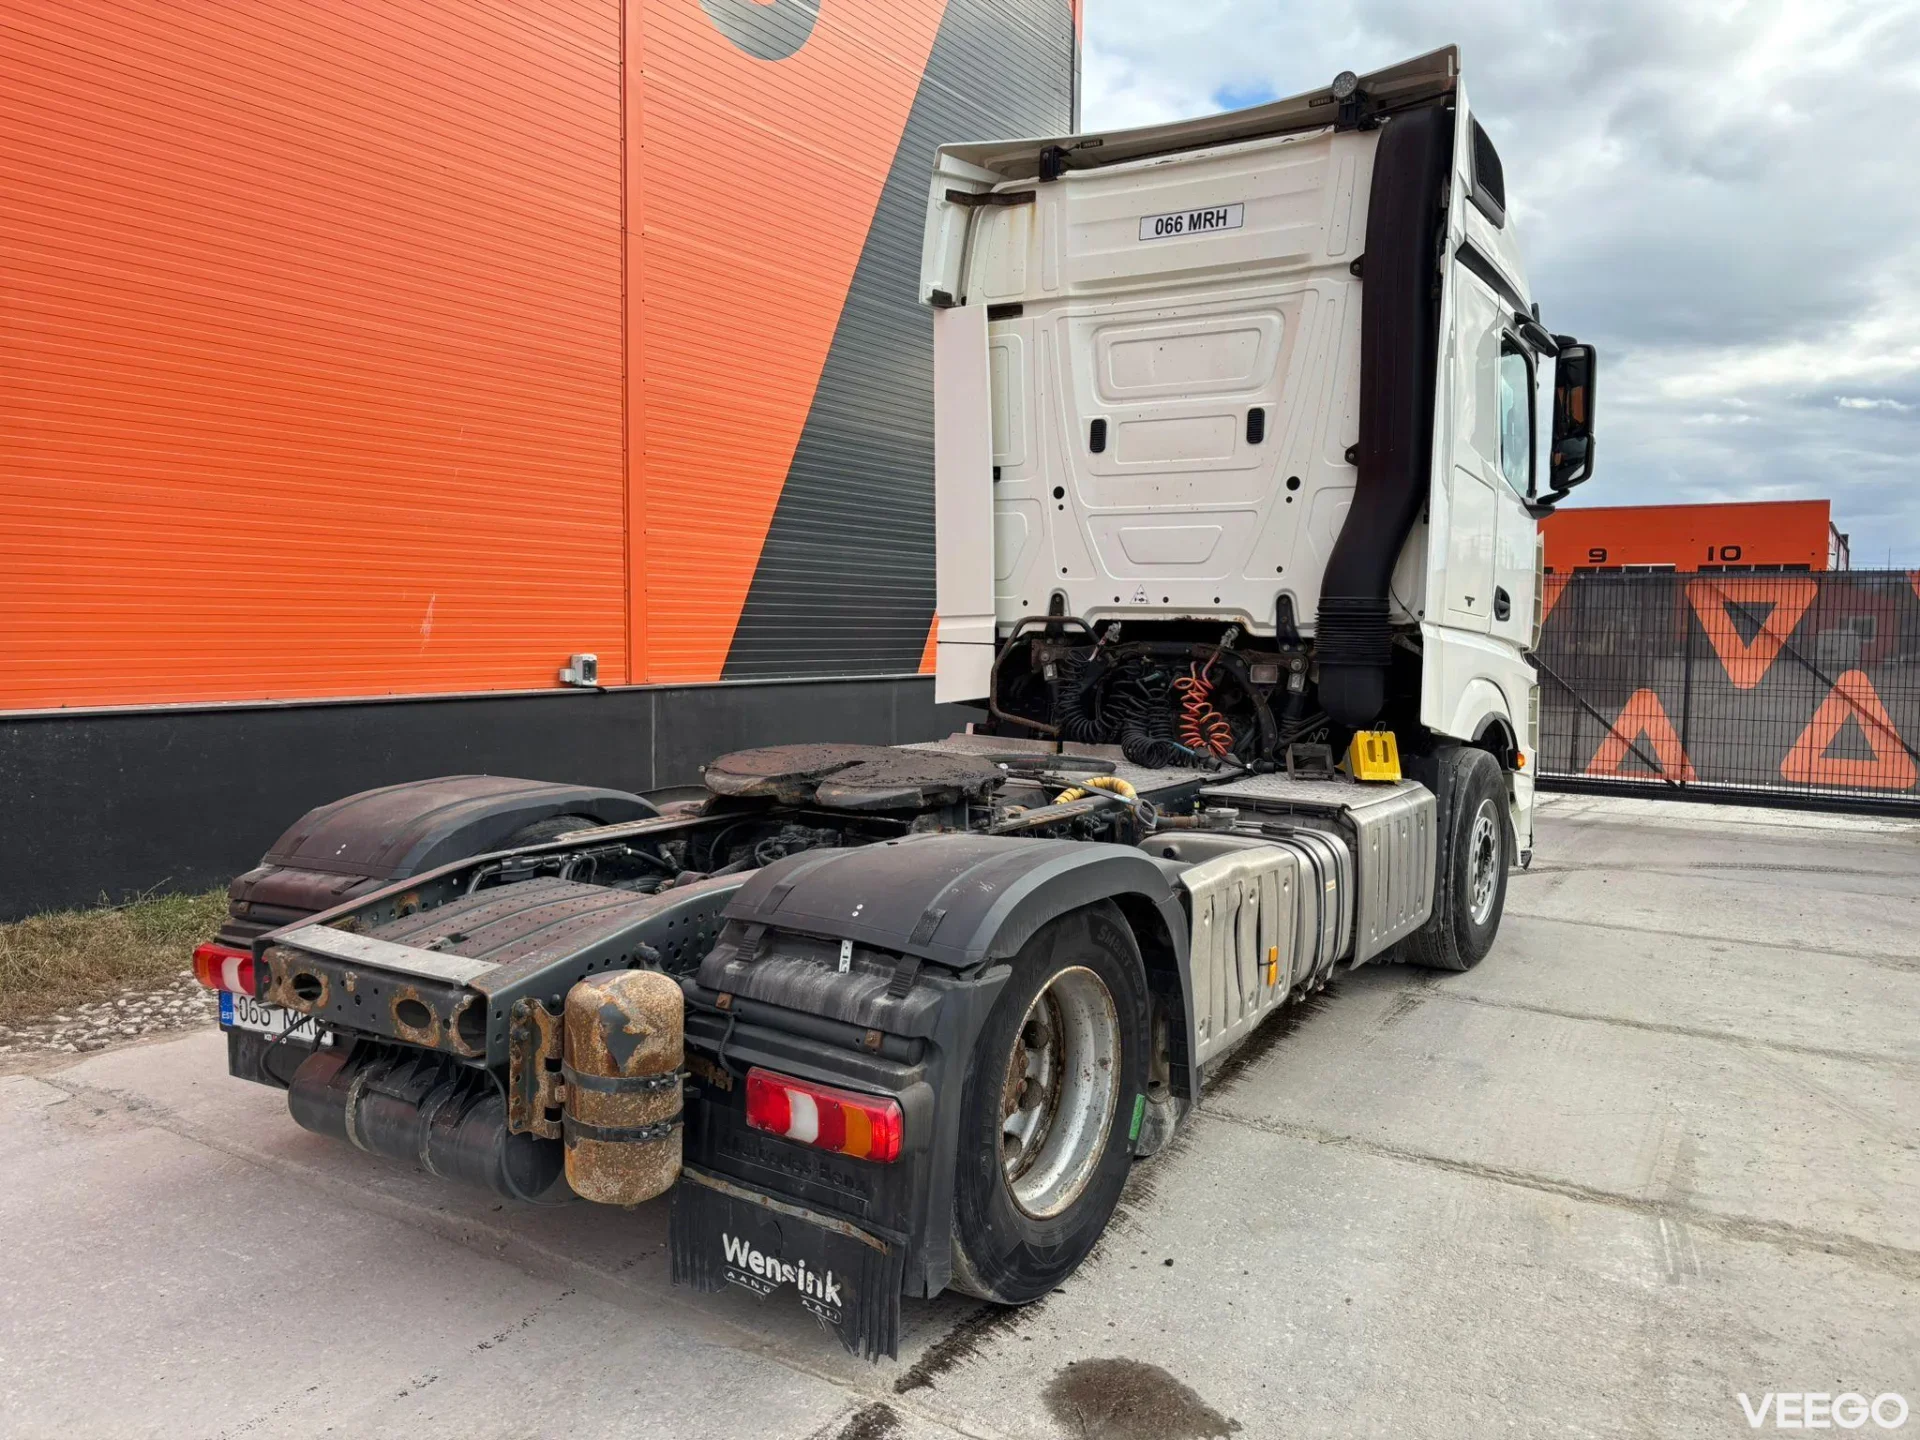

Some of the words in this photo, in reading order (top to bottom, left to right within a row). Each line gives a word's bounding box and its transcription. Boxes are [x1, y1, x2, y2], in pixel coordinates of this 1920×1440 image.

[1155, 215, 1183, 236] 066
[1188, 208, 1228, 231] MRH
[1588, 547, 1608, 564] 9
[1707, 545, 1742, 562] 10
[722, 1232, 842, 1307] Wensink
